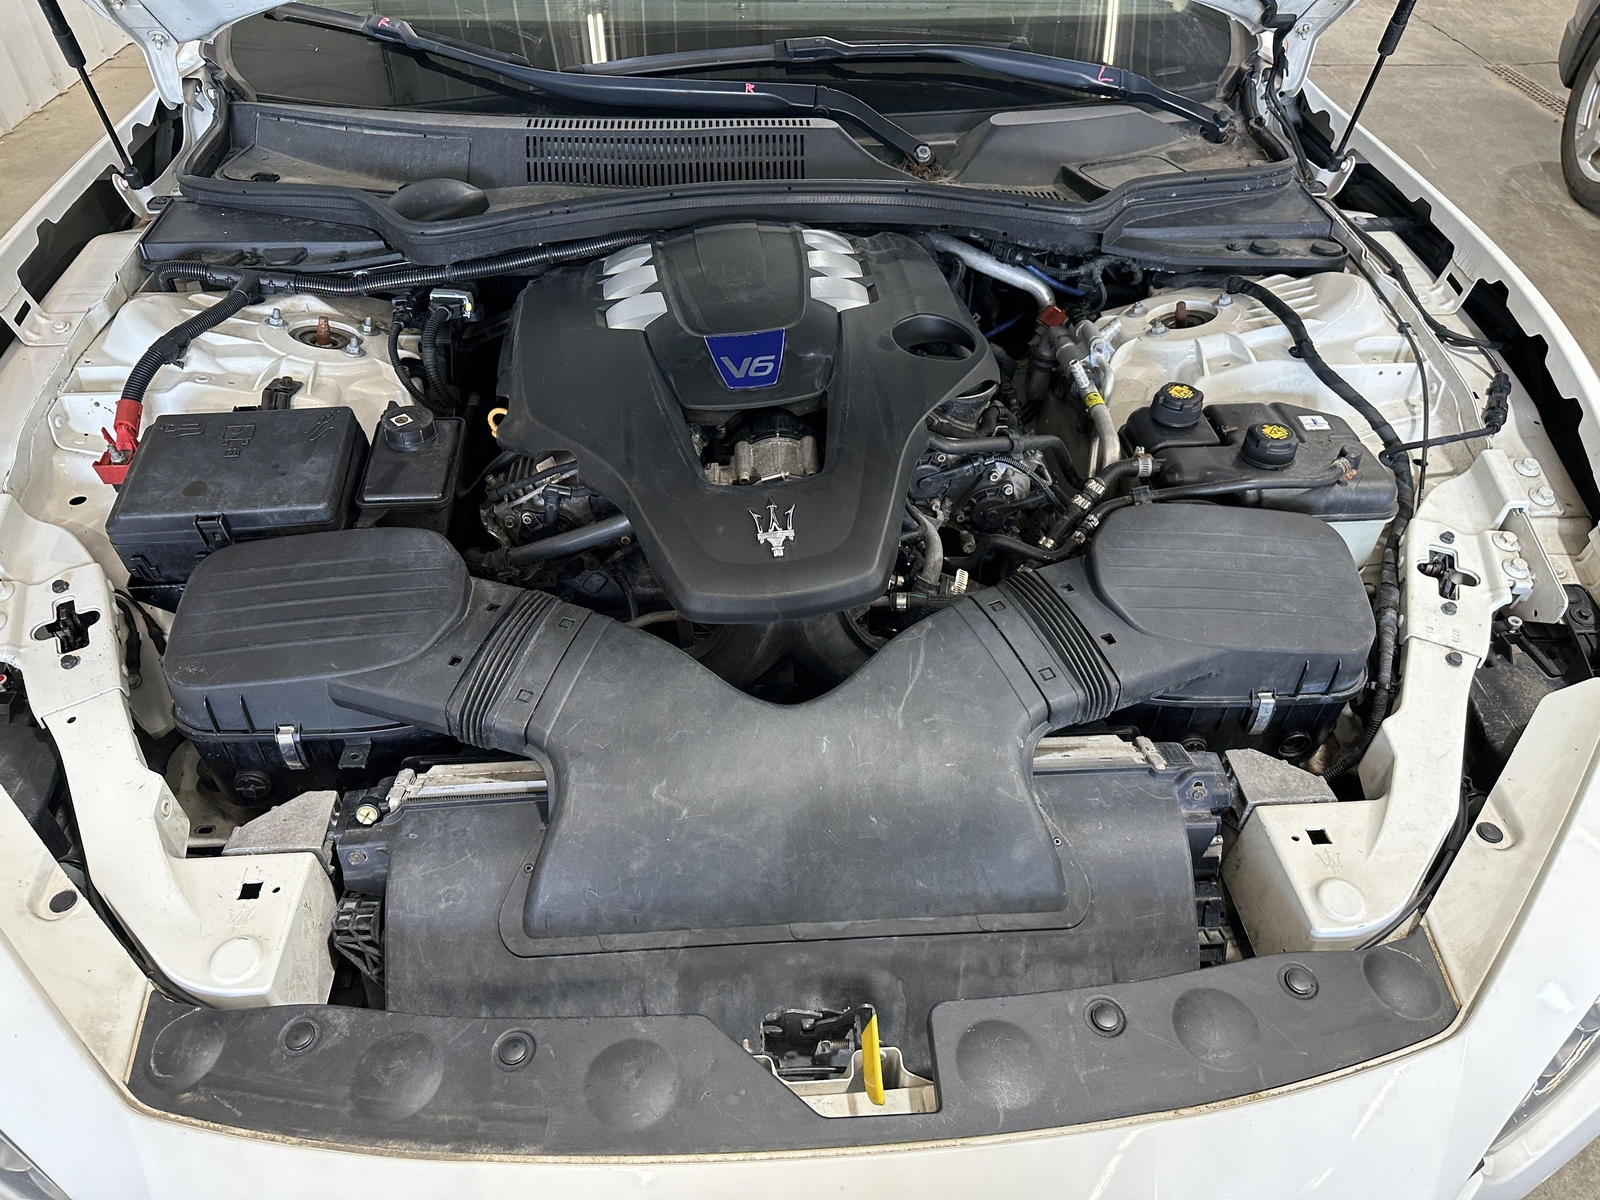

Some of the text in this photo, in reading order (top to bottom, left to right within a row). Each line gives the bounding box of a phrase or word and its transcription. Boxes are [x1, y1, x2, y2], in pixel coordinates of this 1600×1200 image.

[1098, 65, 1113, 81] L
[745, 83, 755, 94] R
[720, 355, 776, 378] V6
